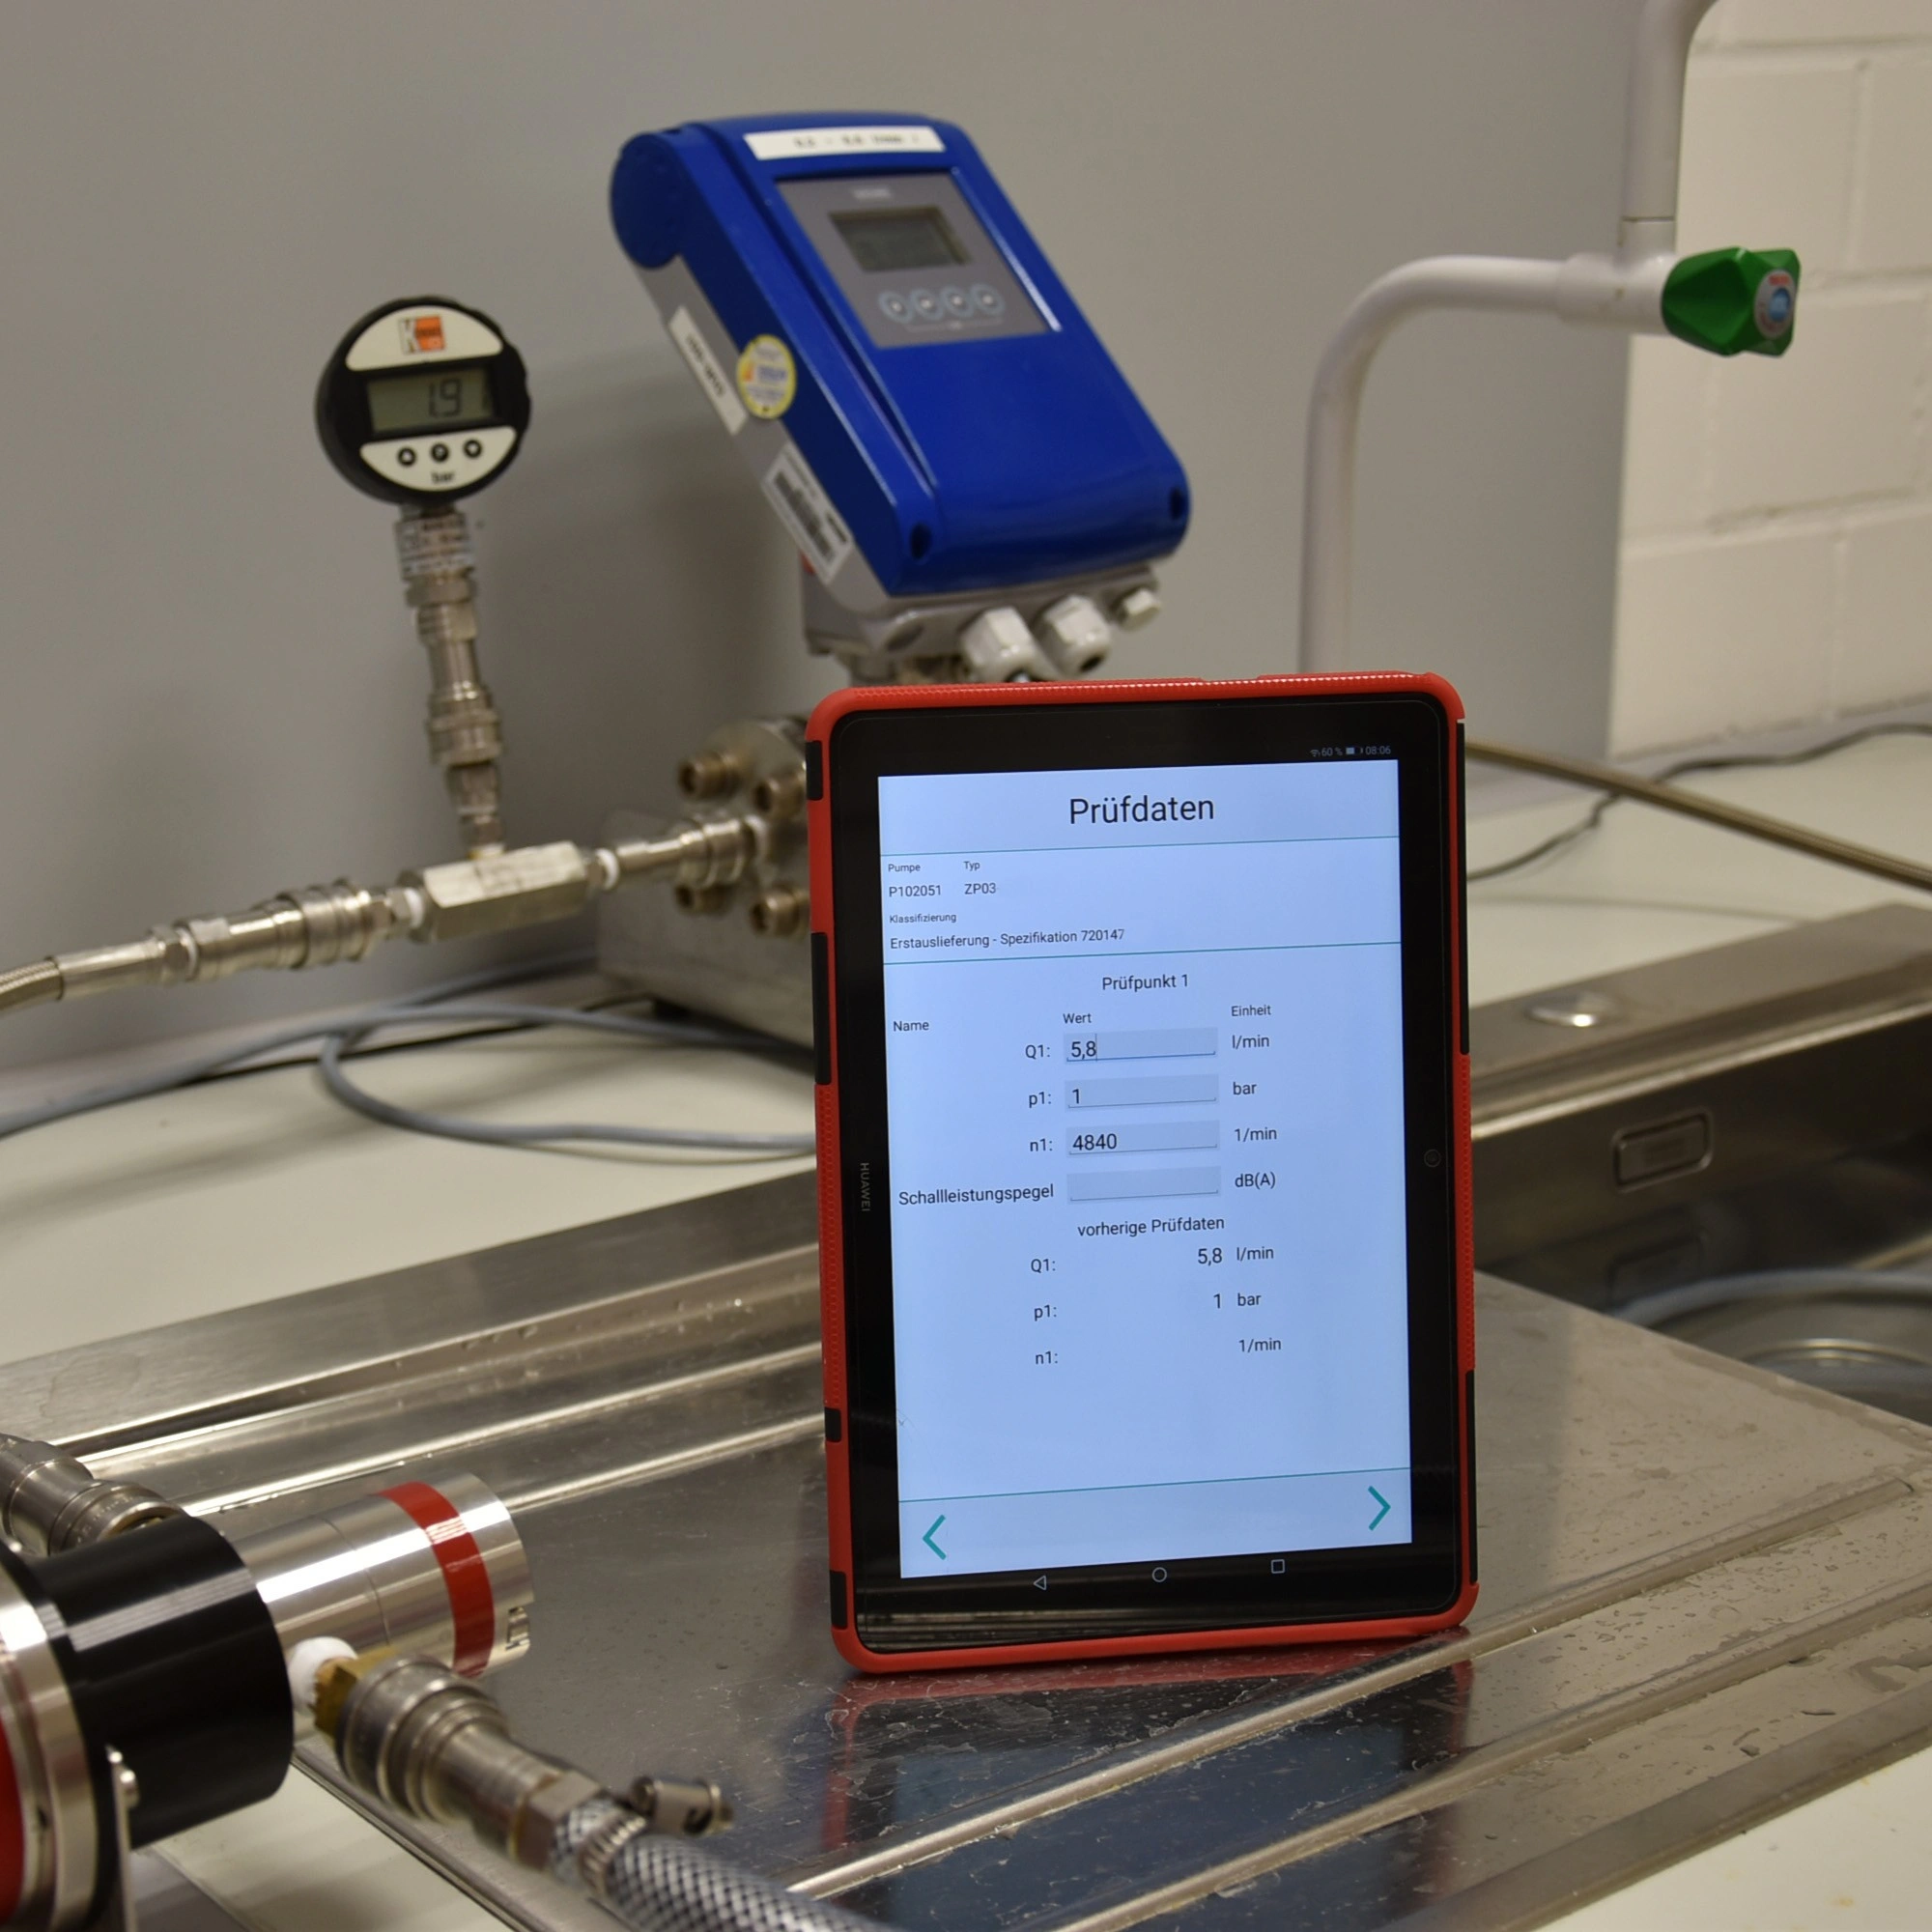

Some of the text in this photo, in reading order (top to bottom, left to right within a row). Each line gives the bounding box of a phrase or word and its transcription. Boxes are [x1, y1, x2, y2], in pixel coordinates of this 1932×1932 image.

[1321, 748, 1333, 757] 60
[1365, 745, 1391, 755] 08:06
[1069, 794, 1214, 825] Prüfdaten
[887, 863, 922, 874] Pumpe
[962, 860, 980, 872] Typ
[888, 884, 942, 898] P102051
[964, 882, 997, 895] ZP03
[888, 911, 957, 925] Klassifizierung
[890, 934, 990, 950] Erstauslieferung
[1000, 930, 1078, 948] Spezifikation
[1080, 928, 1125, 942] 720147
[1101, 973, 1188, 993] Prüfpunkt 1
[1062, 1012, 1093, 1025] Wert
[1231, 1004, 1272, 1017] Einheit
[893, 1020, 930, 1033] Name
[1232, 1034, 1270, 1050] l/min
[1025, 1043, 1051, 1061] Q1:
[1070, 1040, 1097, 1062] 5,8
[1071, 1088, 1080, 1105] 1
[1232, 1081, 1258, 1096] bar
[1028, 1091, 1052, 1109] p1:
[1071, 1132, 1118, 1152] 4840
[1234, 1126, 1278, 1143] 1/min
[1029, 1137, 1053, 1152] n1:
[859, 1162, 871, 1212] HUAWEI
[1235, 1171, 1276, 1190] dB(A)
[898, 1182, 1054, 1206] Schallleistungspegel
[1077, 1216, 1225, 1238] vorherige Prüfdaten
[1197, 1247, 1223, 1266] 5,8
[1236, 1245, 1274, 1263] l/min
[1030, 1258, 1056, 1274] Q1:
[1212, 1293, 1221, 1310] 1
[1236, 1292, 1263, 1307] bar
[1034, 1304, 1057, 1322] p1:
[1238, 1337, 1282, 1353] 1/min
[1035, 1350, 1059, 1365] n1:
